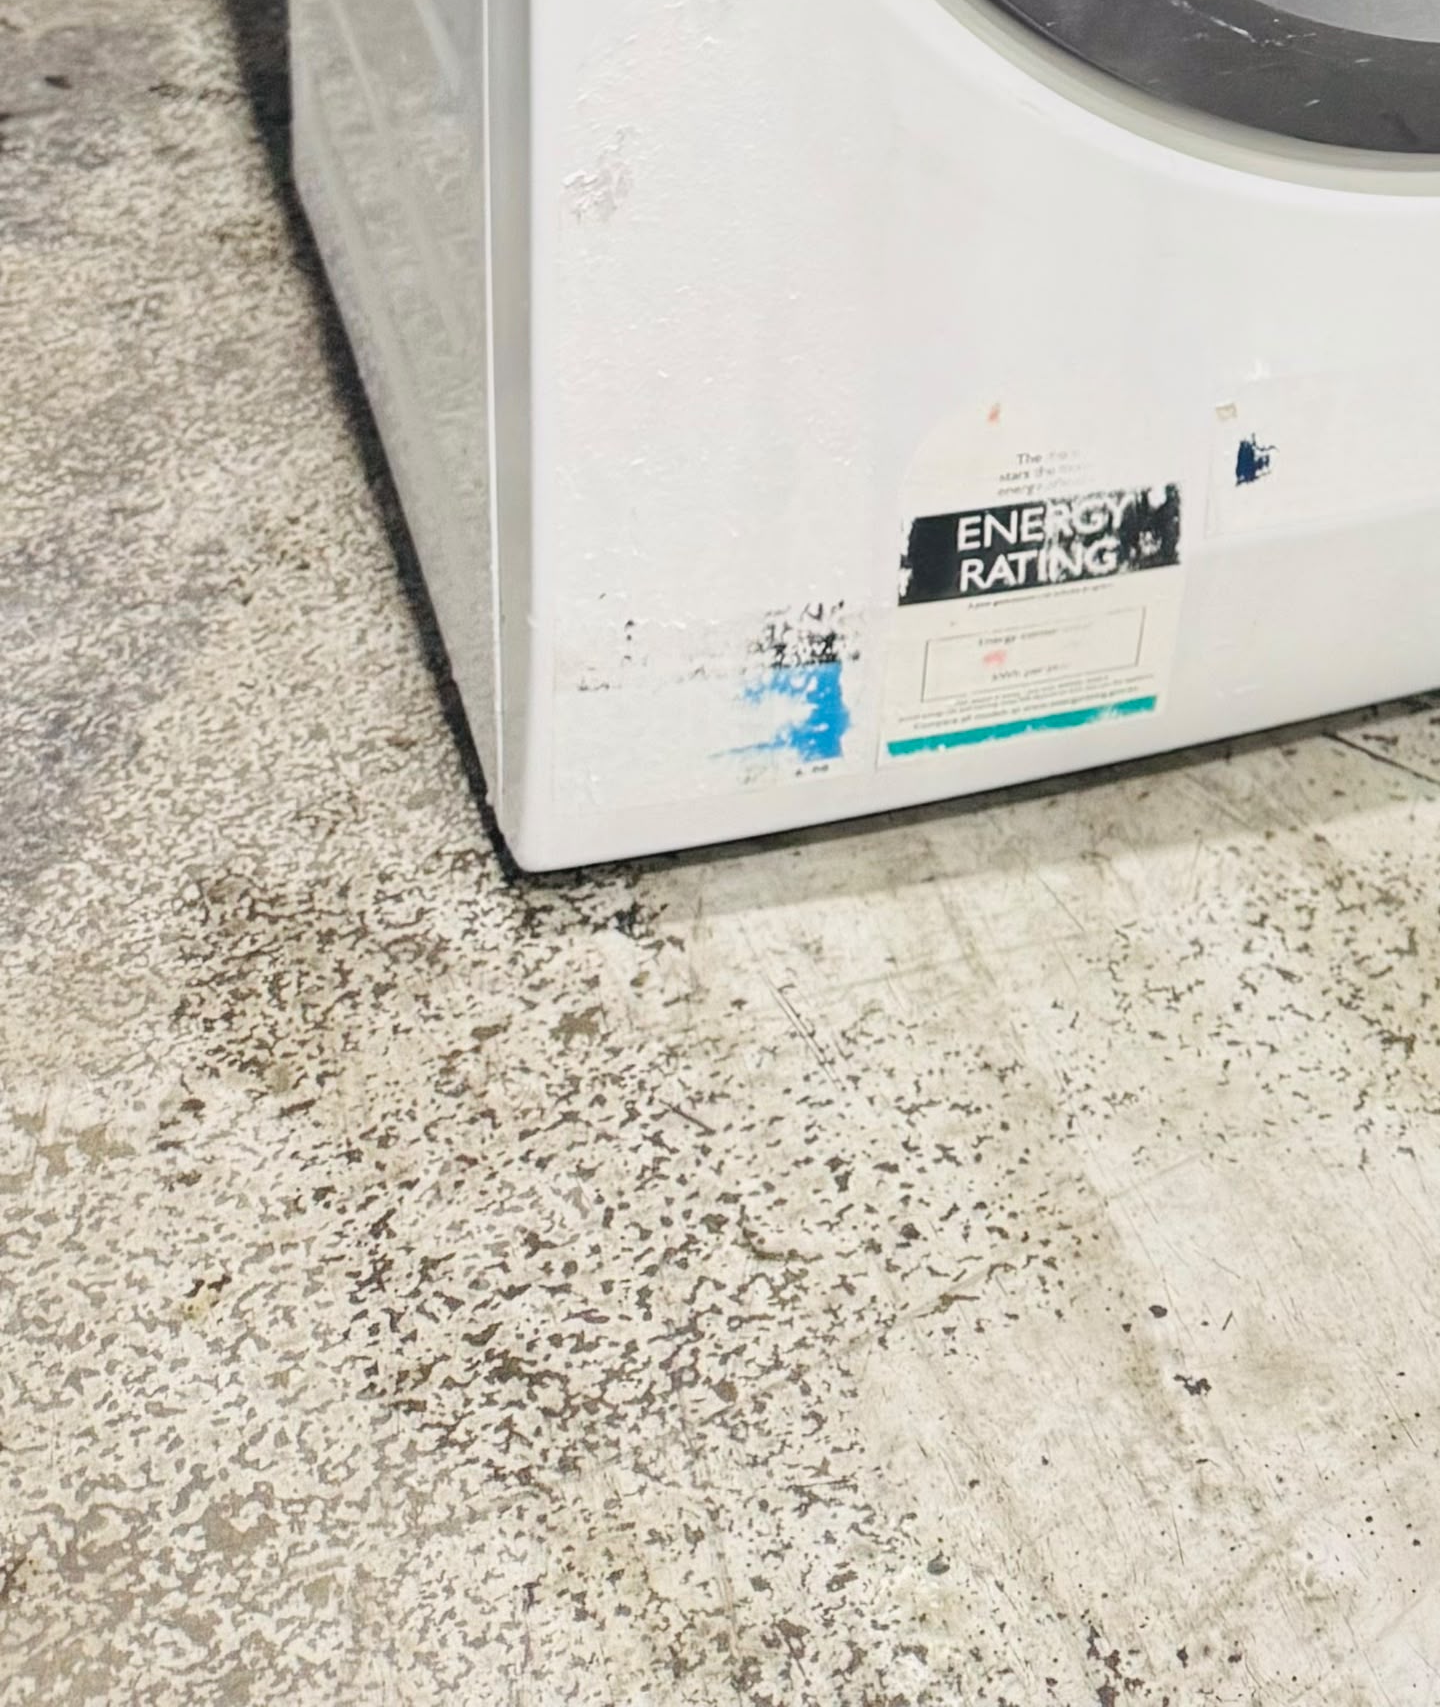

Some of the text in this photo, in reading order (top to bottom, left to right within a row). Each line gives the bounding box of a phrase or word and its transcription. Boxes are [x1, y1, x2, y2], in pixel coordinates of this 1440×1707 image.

[999, 469, 1030, 483] stars
[1017, 453, 1042, 466] The
[956, 496, 1135, 552] ENERGY
[959, 535, 1121, 592] RATING
